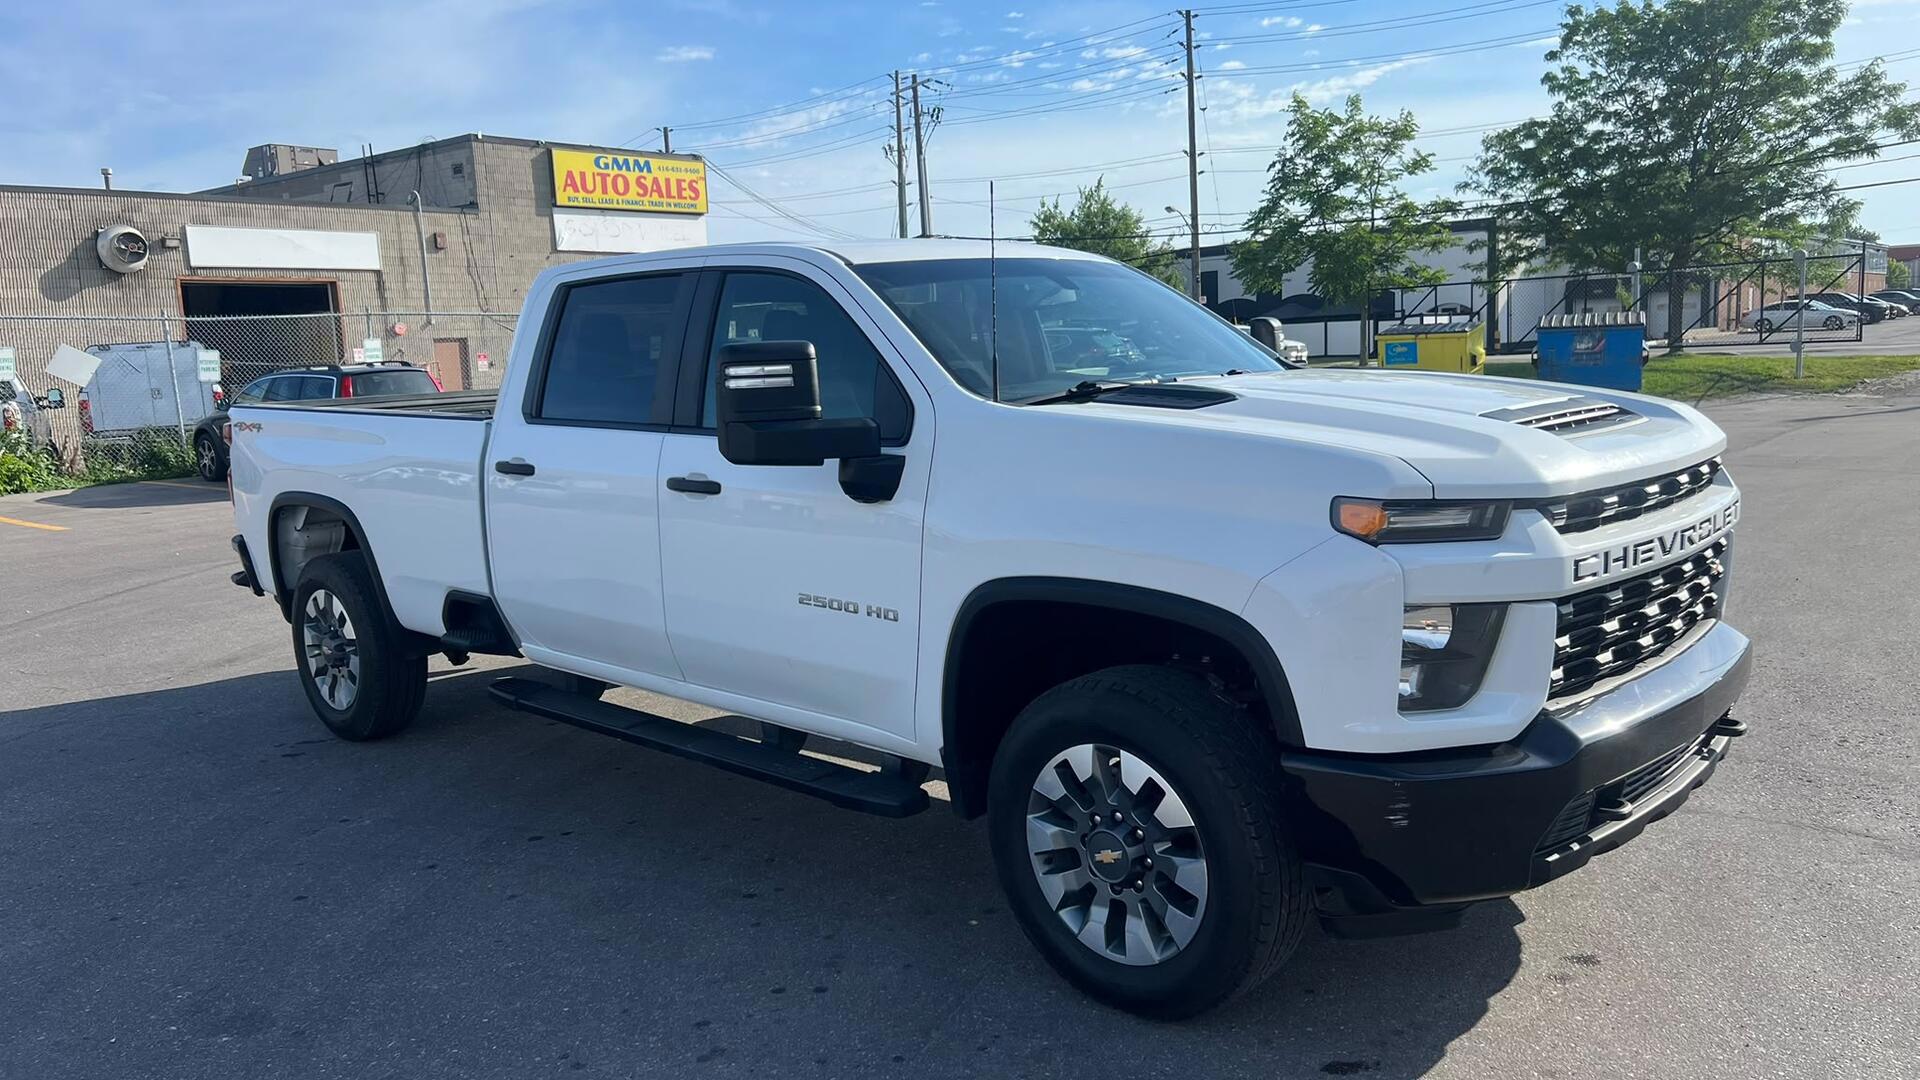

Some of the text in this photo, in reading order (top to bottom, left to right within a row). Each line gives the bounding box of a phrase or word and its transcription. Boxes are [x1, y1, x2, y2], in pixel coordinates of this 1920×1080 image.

[594, 155, 652, 173] GMM
[563, 170, 700, 201] AUTO SALES
[1573, 501, 1739, 583] CHEVROLET
[798, 593, 899, 622] 2500 HD
